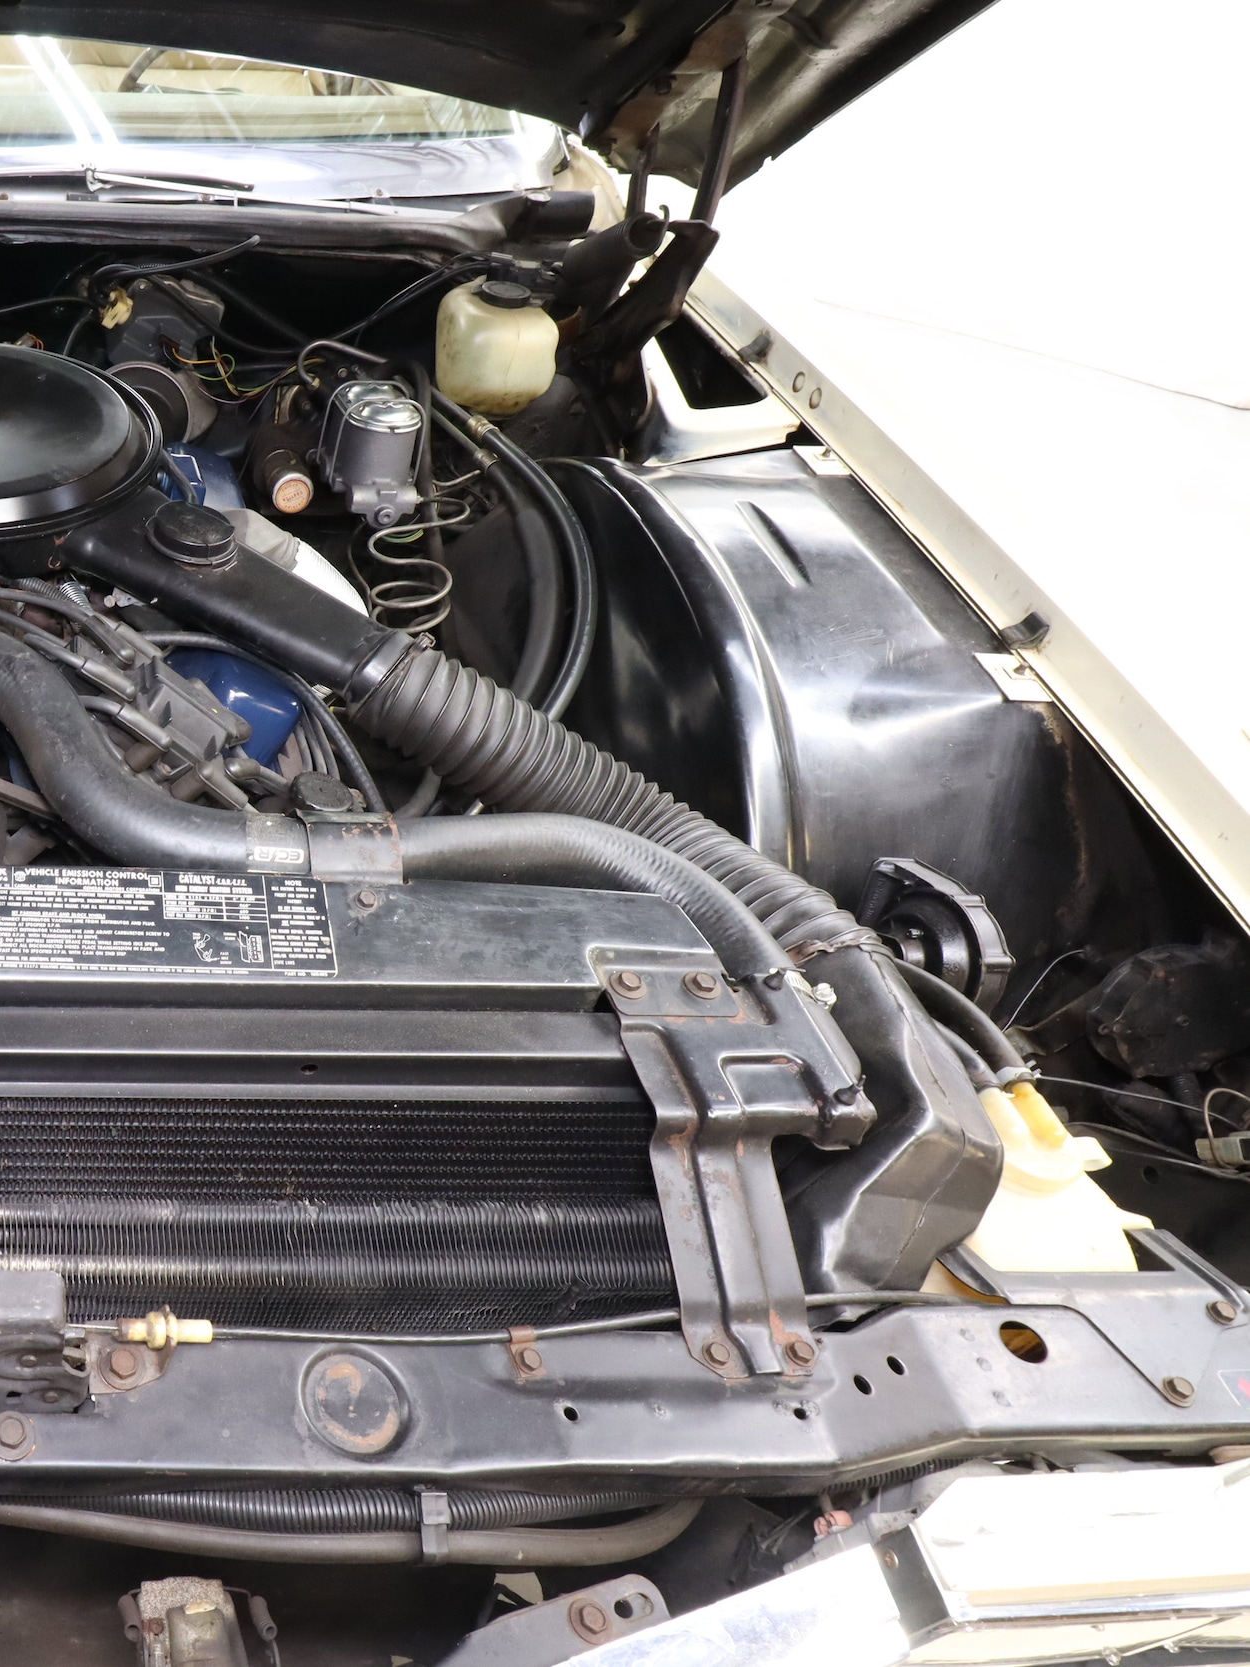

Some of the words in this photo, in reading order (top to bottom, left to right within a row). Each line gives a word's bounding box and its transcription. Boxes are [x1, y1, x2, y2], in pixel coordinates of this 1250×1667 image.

[25, 868, 60, 877] VEHICLE
[62, 869, 103, 878] EMISSION
[106, 871, 148, 881] CONTROL
[179, 874, 215, 885] CATALYST
[55, 877, 119, 887] INFORMATION
